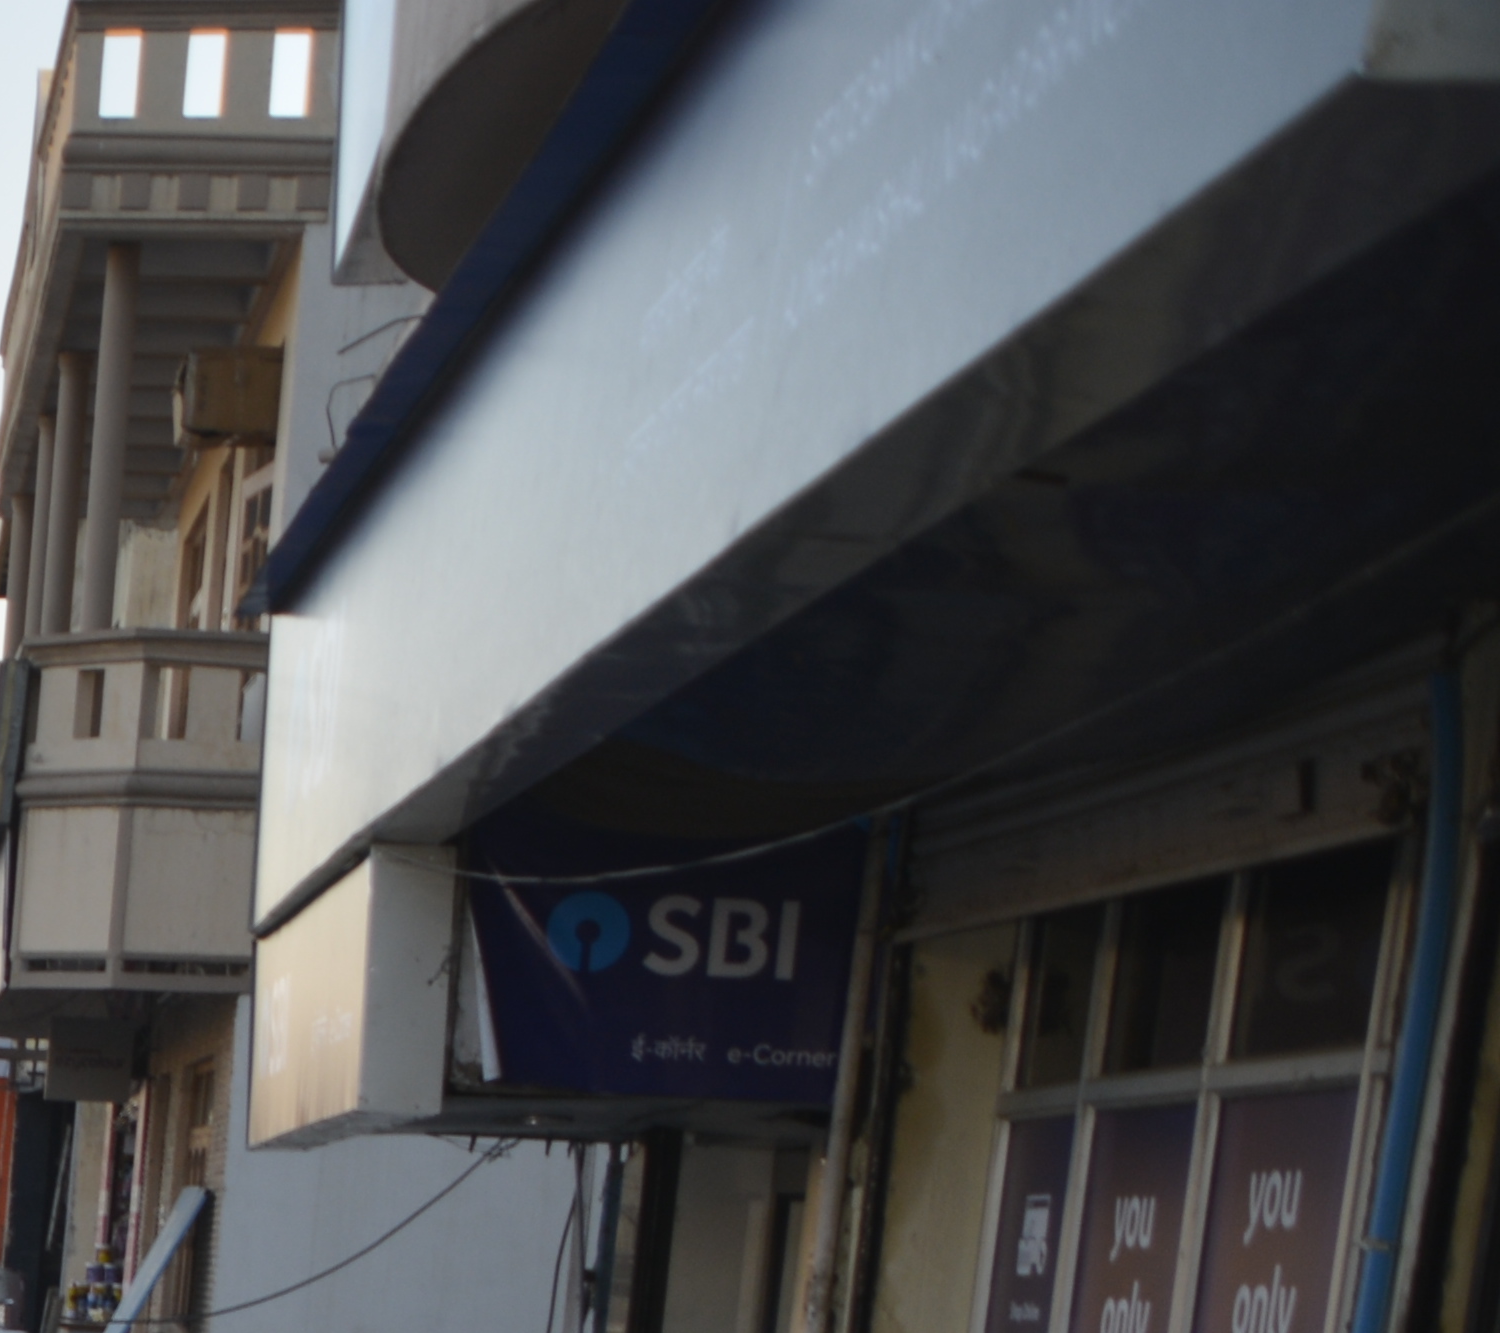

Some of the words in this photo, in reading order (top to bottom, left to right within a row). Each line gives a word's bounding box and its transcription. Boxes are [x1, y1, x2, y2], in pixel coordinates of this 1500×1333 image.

[642, 894, 802, 983] SBI
[726, 1042, 840, 1070] e-Corner
[1110, 1195, 1156, 1262] you
[1243, 1167, 1301, 1246] you
